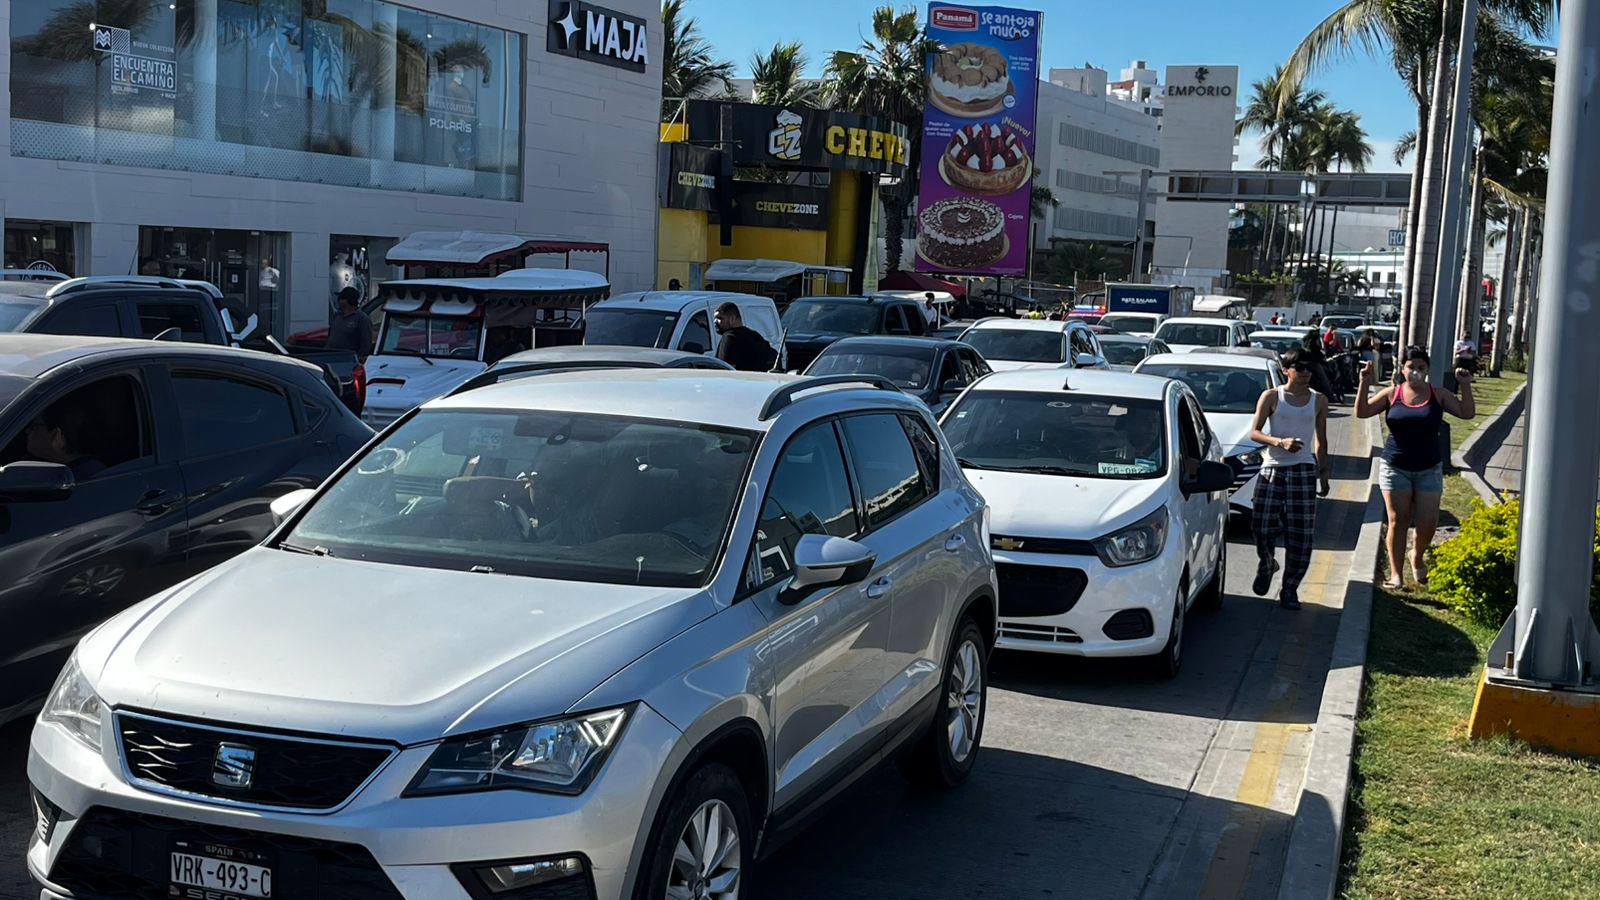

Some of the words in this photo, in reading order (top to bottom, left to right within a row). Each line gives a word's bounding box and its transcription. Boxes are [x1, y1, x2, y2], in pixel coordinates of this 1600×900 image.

[936, 12, 973, 22] Panamá
[995, 14, 1035, 28] antoja
[585, 10, 649, 65] MAJA
[989, 25, 1030, 38] mucho
[113, 55, 174, 76] ENCUENTRA
[113, 68, 127, 82] EL
[130, 71, 174, 89] CAMINO
[1168, 85, 1232, 97] EMPORIO
[429, 118, 472, 133] POLARIS
[1001, 115, 1032, 137] ¡Nuevo!
[825, 125, 910, 167] CHEVE
[677, 171, 716, 189] CHEVEZONE
[755, 200, 819, 215] CHEVEZONE
[205, 845, 234, 856] SPAIN
[172, 854, 270, 896] VRK-493-C
[186, 888, 248, 900] SE
